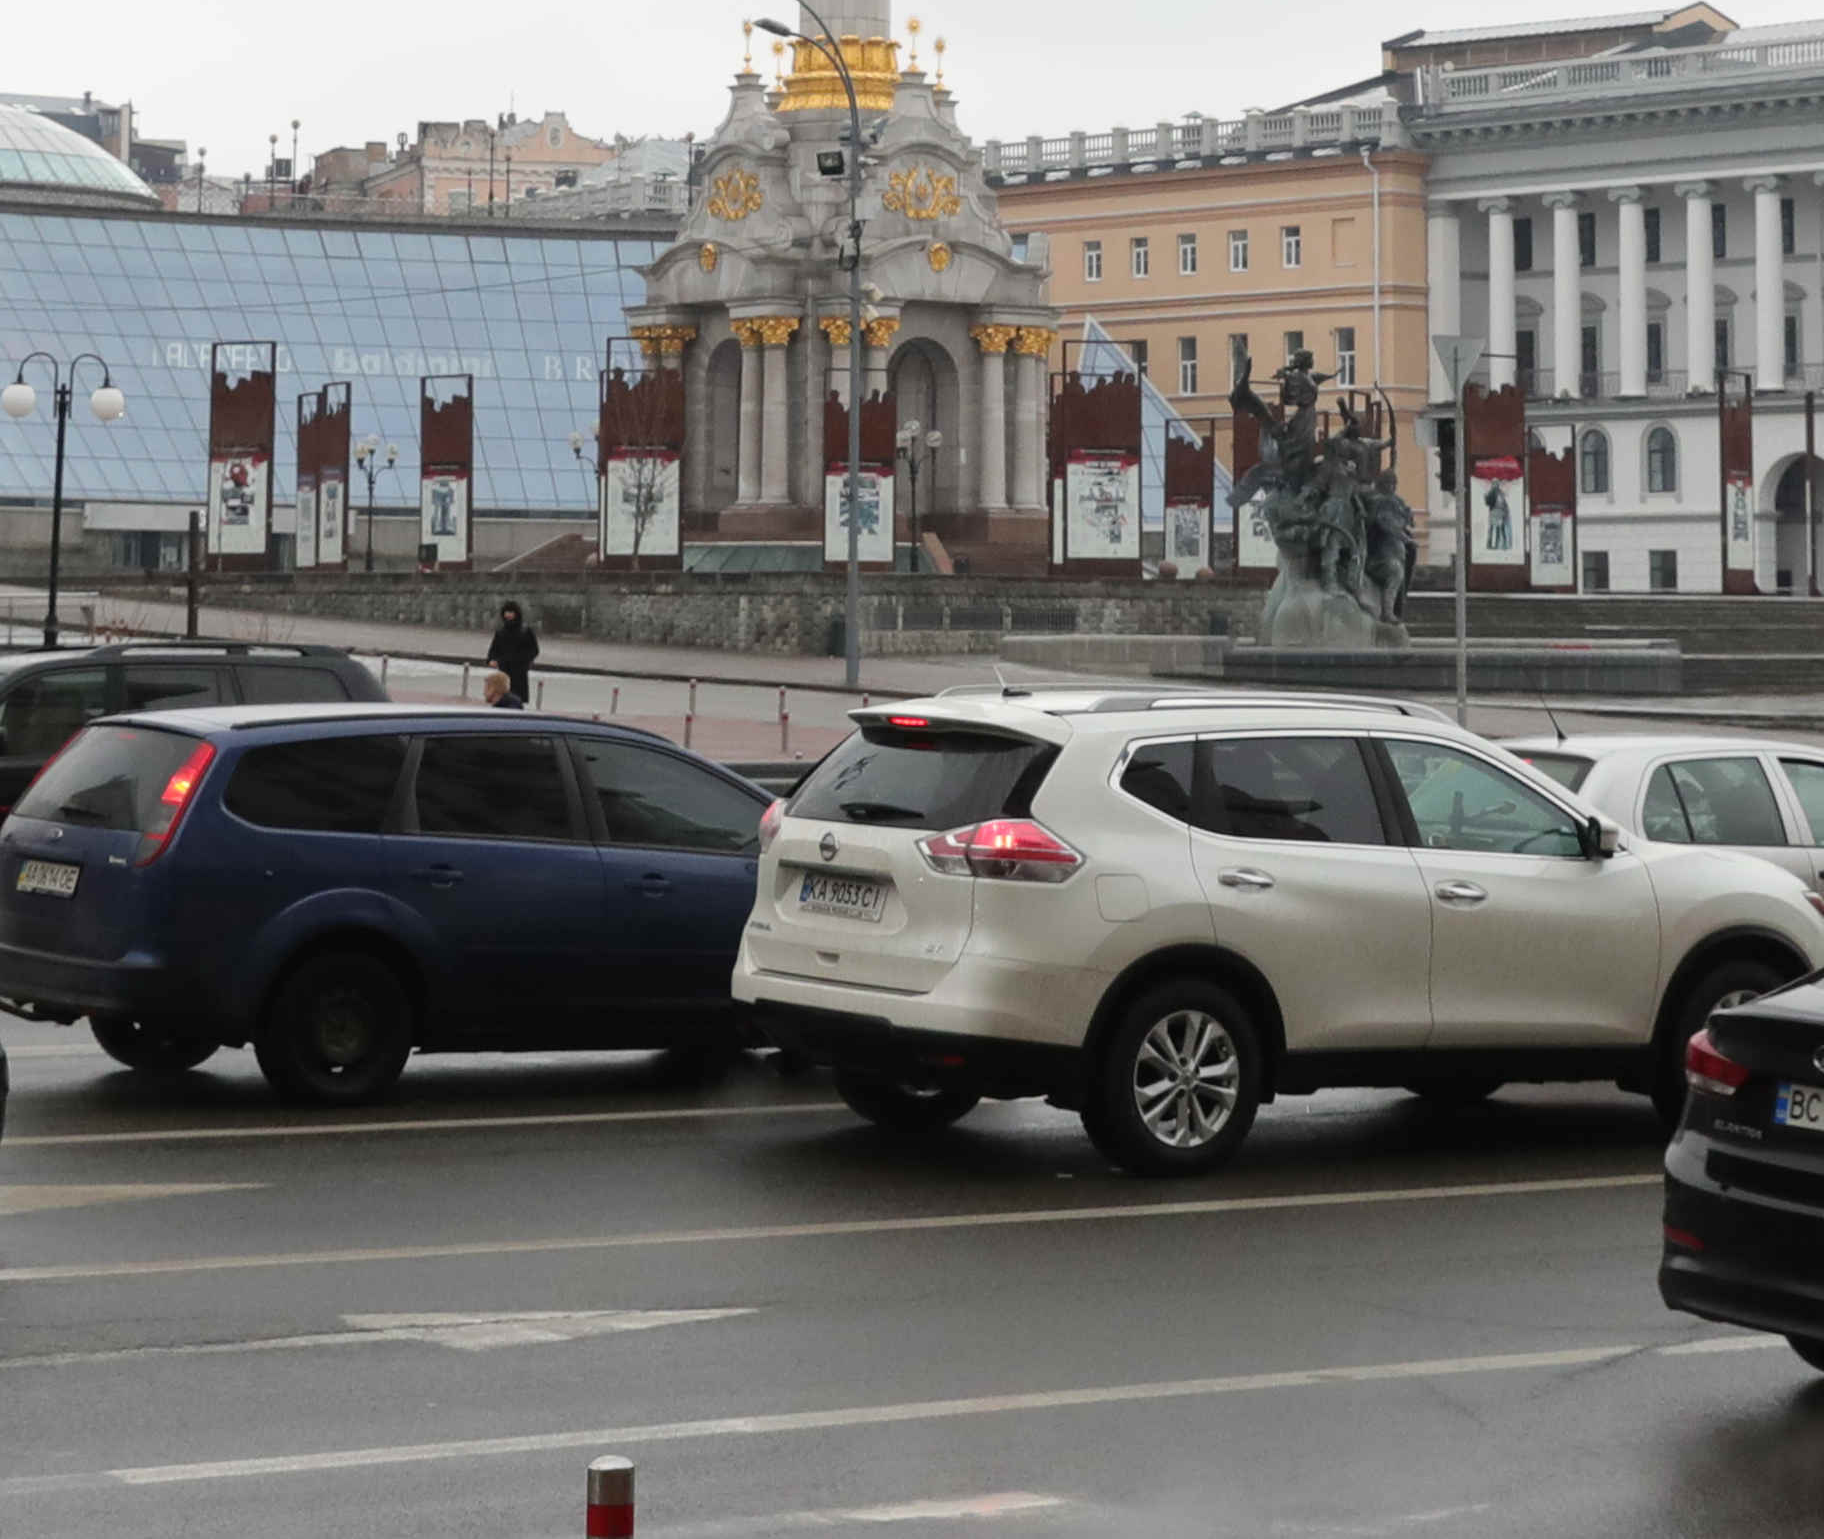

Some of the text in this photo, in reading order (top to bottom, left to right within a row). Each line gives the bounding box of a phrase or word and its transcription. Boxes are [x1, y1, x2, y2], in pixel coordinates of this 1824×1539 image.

[809, 879, 881, 909] KA 9053 CI
[1789, 1089, 1822, 1123] BC
